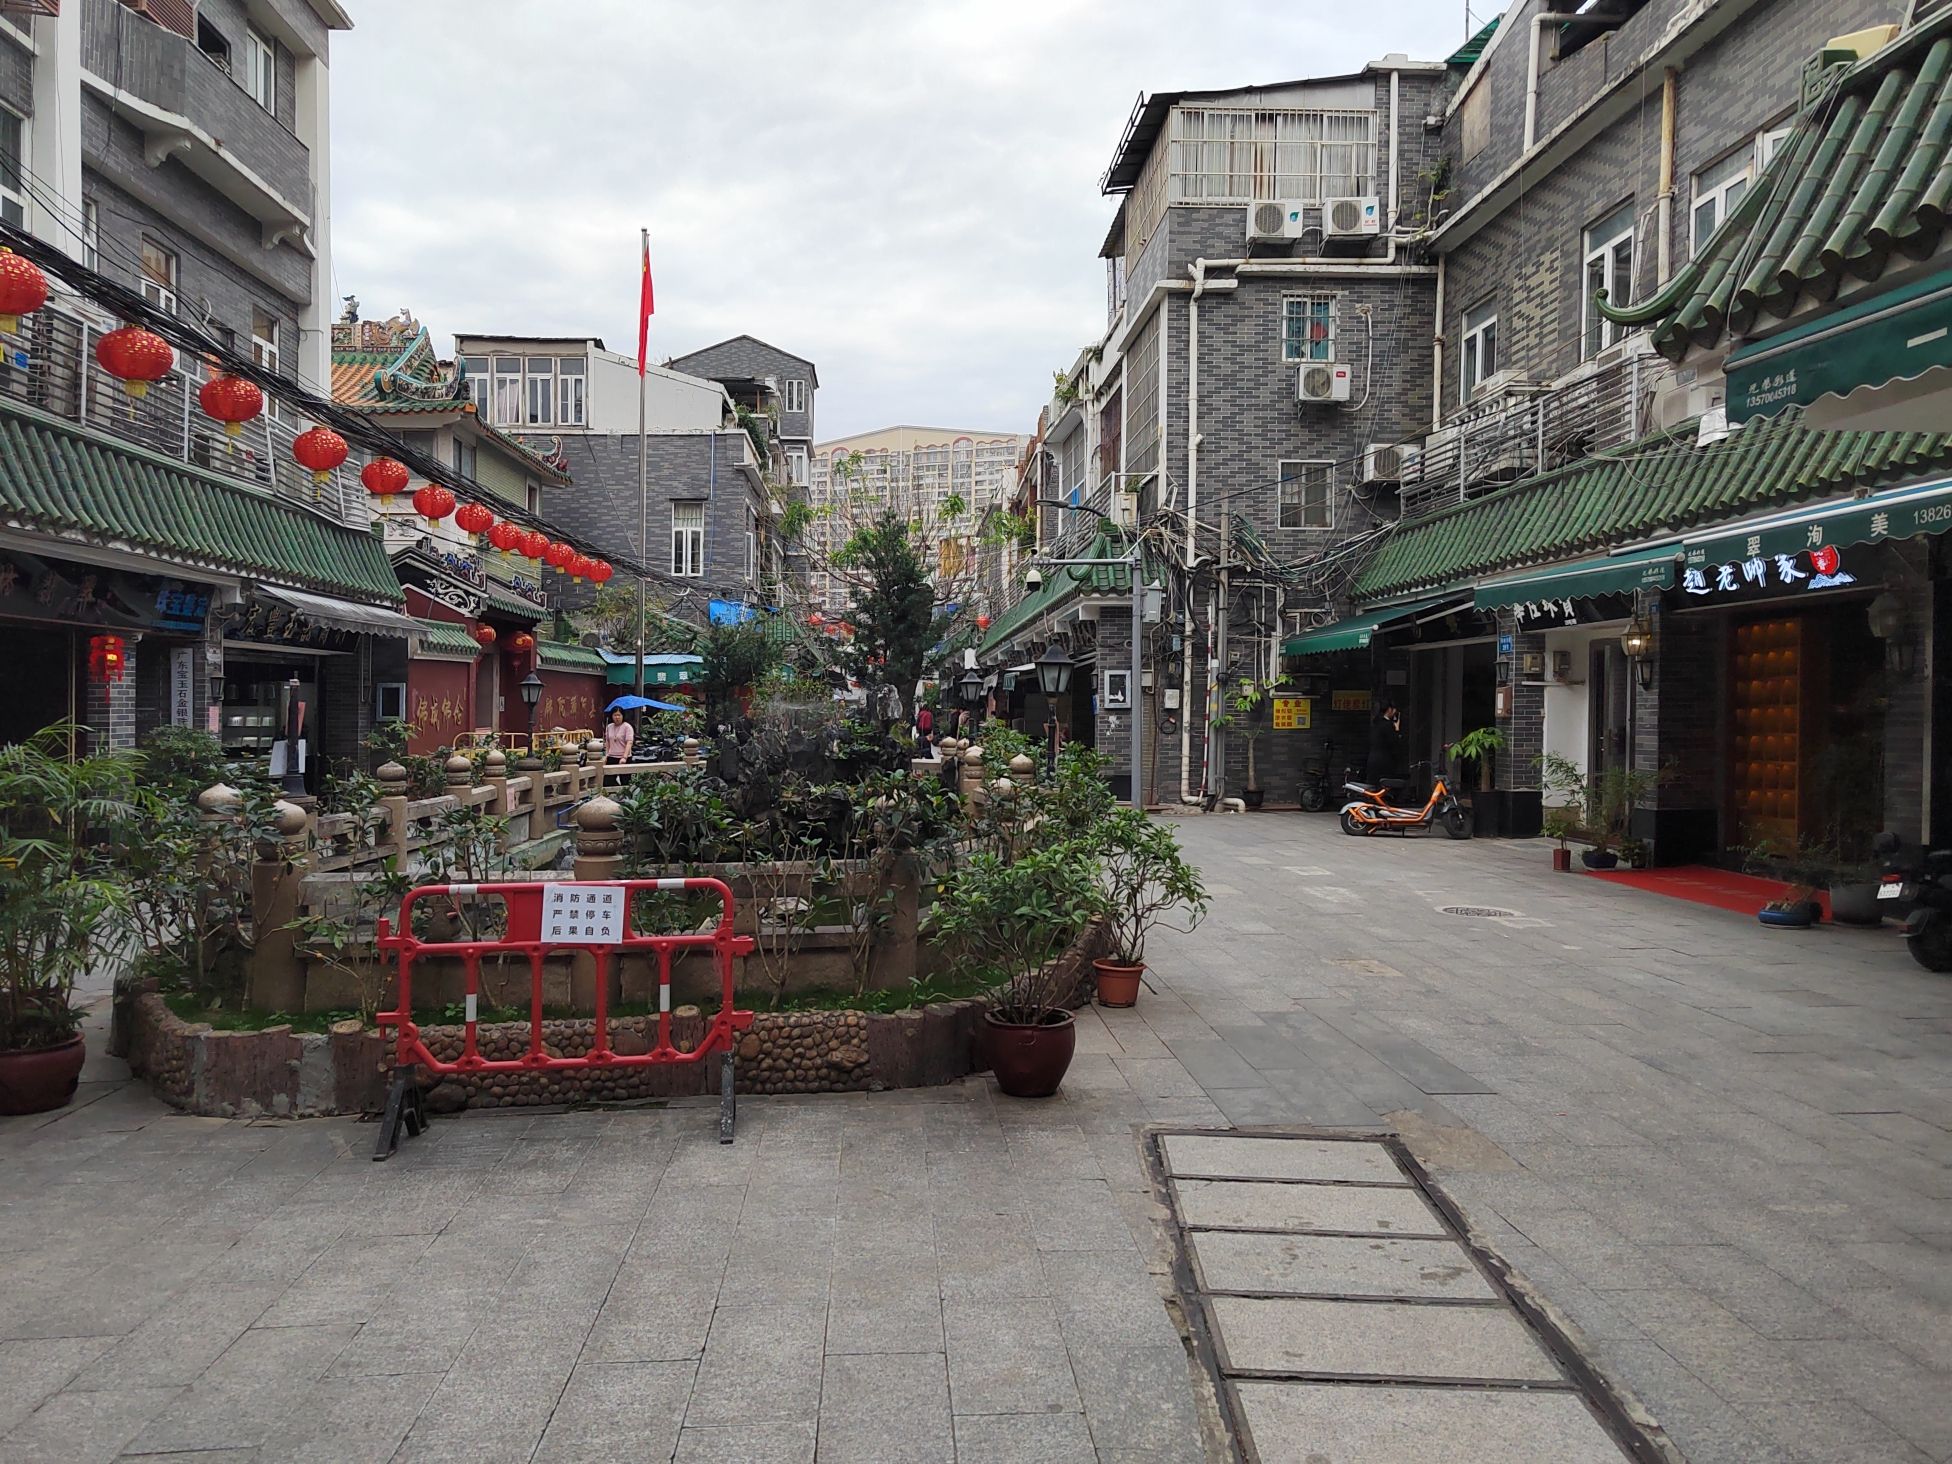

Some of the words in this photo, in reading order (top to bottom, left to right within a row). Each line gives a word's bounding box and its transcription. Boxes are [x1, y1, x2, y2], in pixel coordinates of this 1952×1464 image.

[1746, 383, 1797, 408] 13570045318
[552, 893, 613, 904] 消防通道
[552, 909, 612, 920] 严禁停车
[551, 925, 611, 937] 后果自负
